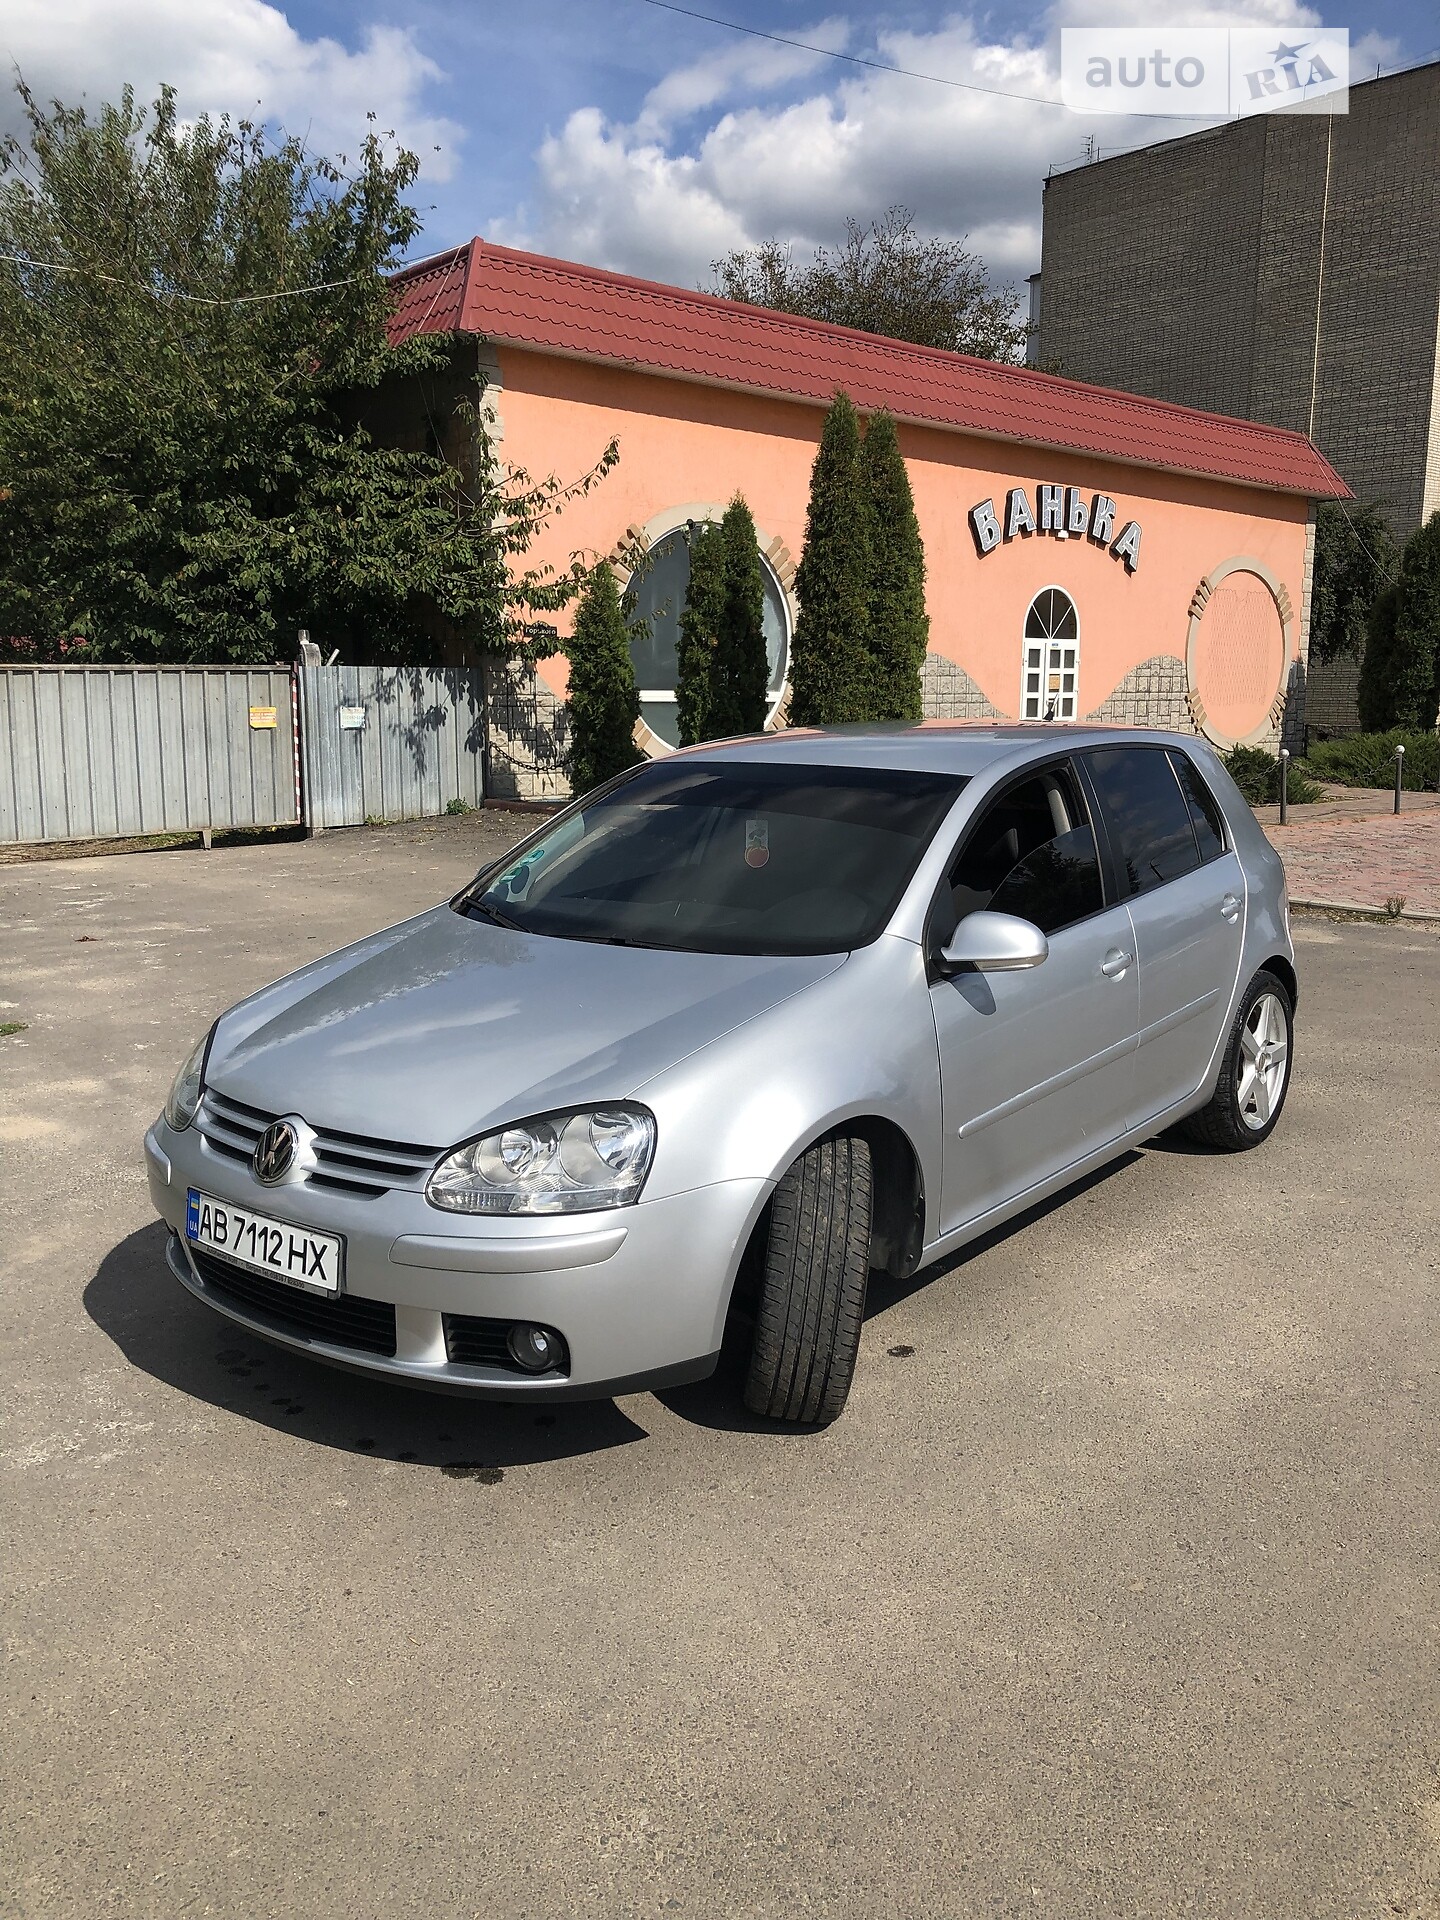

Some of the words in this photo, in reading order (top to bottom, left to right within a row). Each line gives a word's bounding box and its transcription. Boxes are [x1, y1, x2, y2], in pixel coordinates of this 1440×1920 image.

[968, 484, 1143, 572] БАНЬКА
[189, 1220, 198, 1233] UA
[200, 1204, 228, 1245] AB
[233, 1215, 283, 1267] 7112
[288, 1233, 328, 1281] HX
